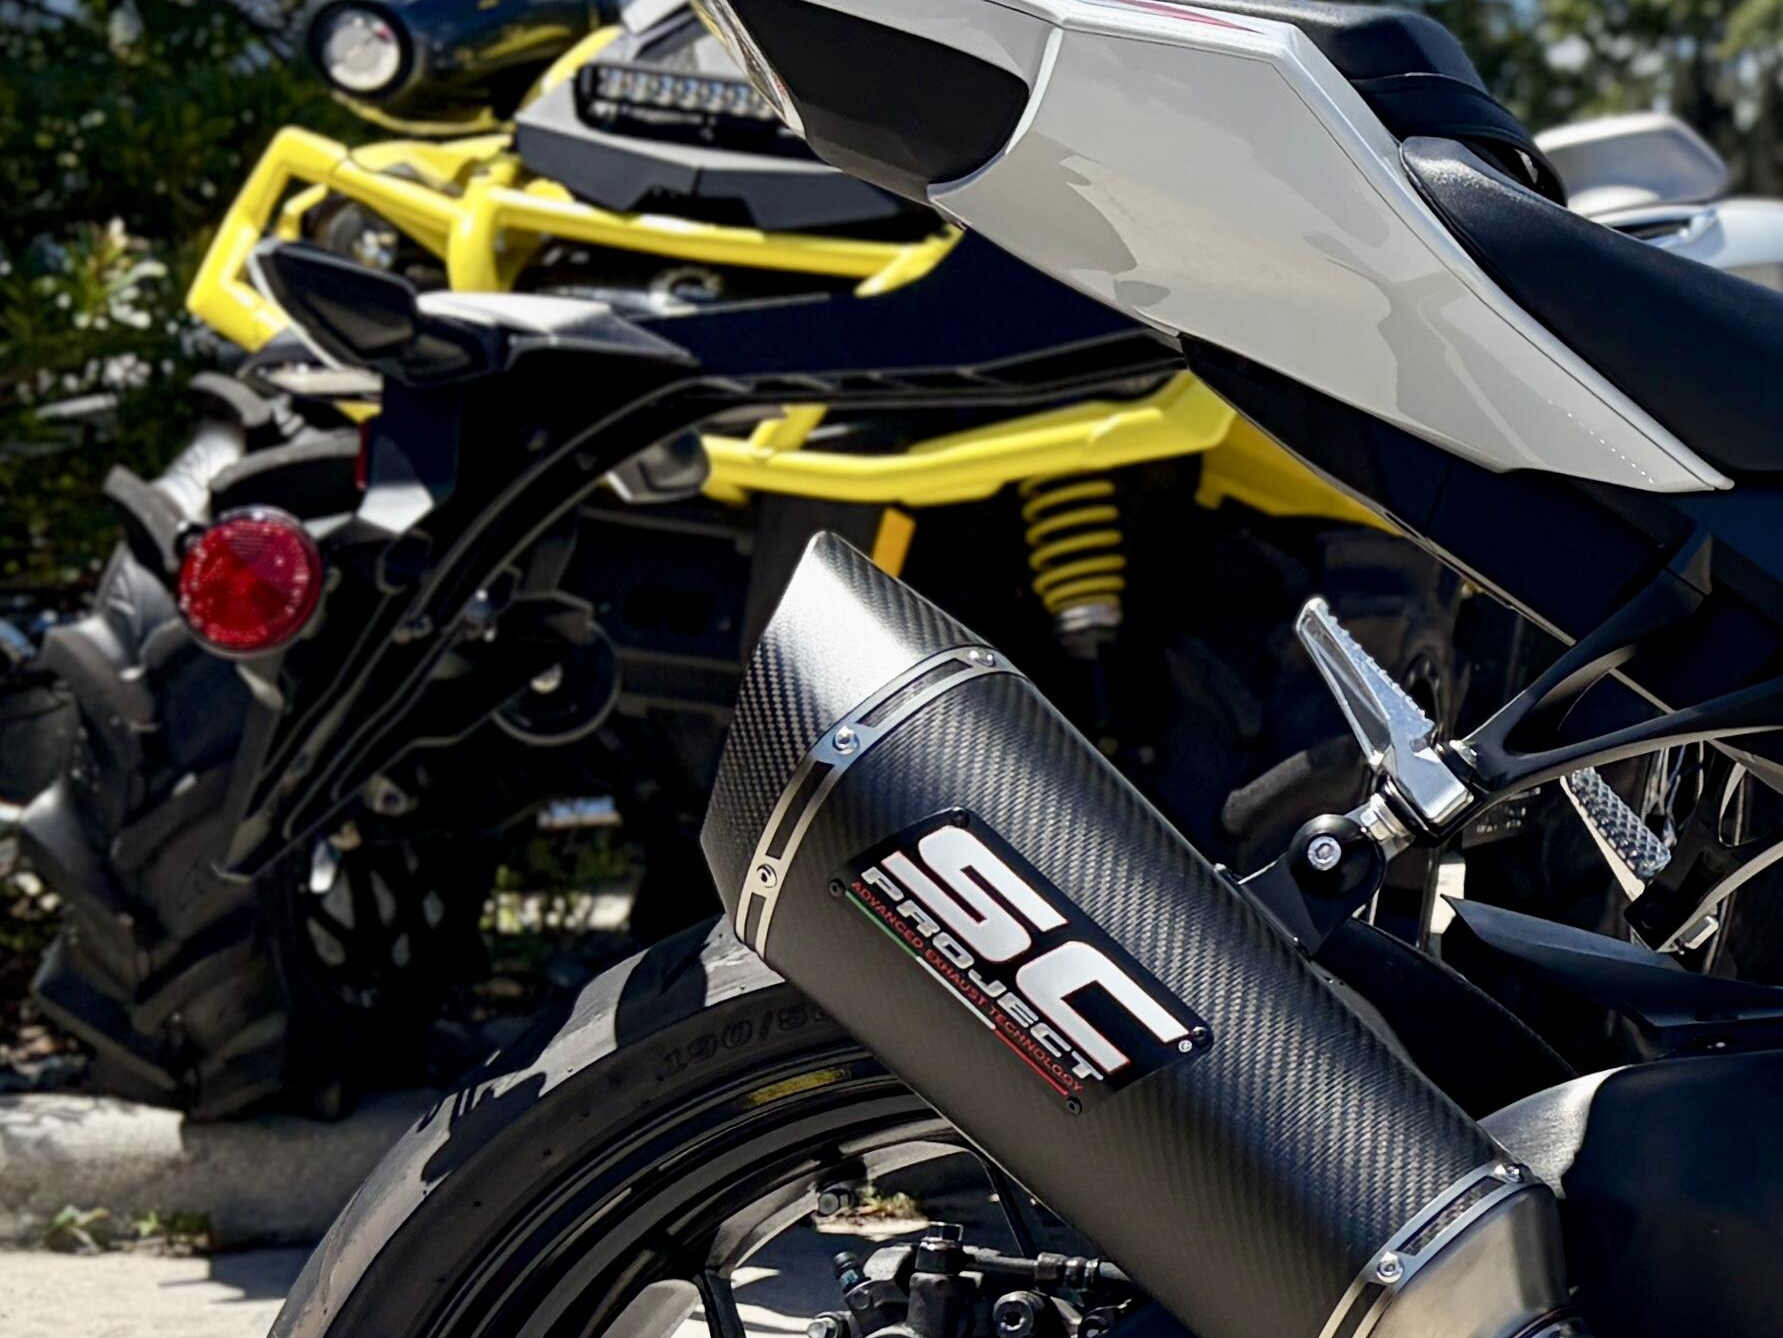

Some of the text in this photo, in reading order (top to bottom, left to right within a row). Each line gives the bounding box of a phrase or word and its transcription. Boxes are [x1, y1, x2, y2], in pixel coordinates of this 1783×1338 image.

[851, 880, 1085, 1095] ADVANCED EXHAUST TECHNOLOGY
[860, 865, 1105, 1082] PROJECT
[880, 823, 1190, 1076] SC
